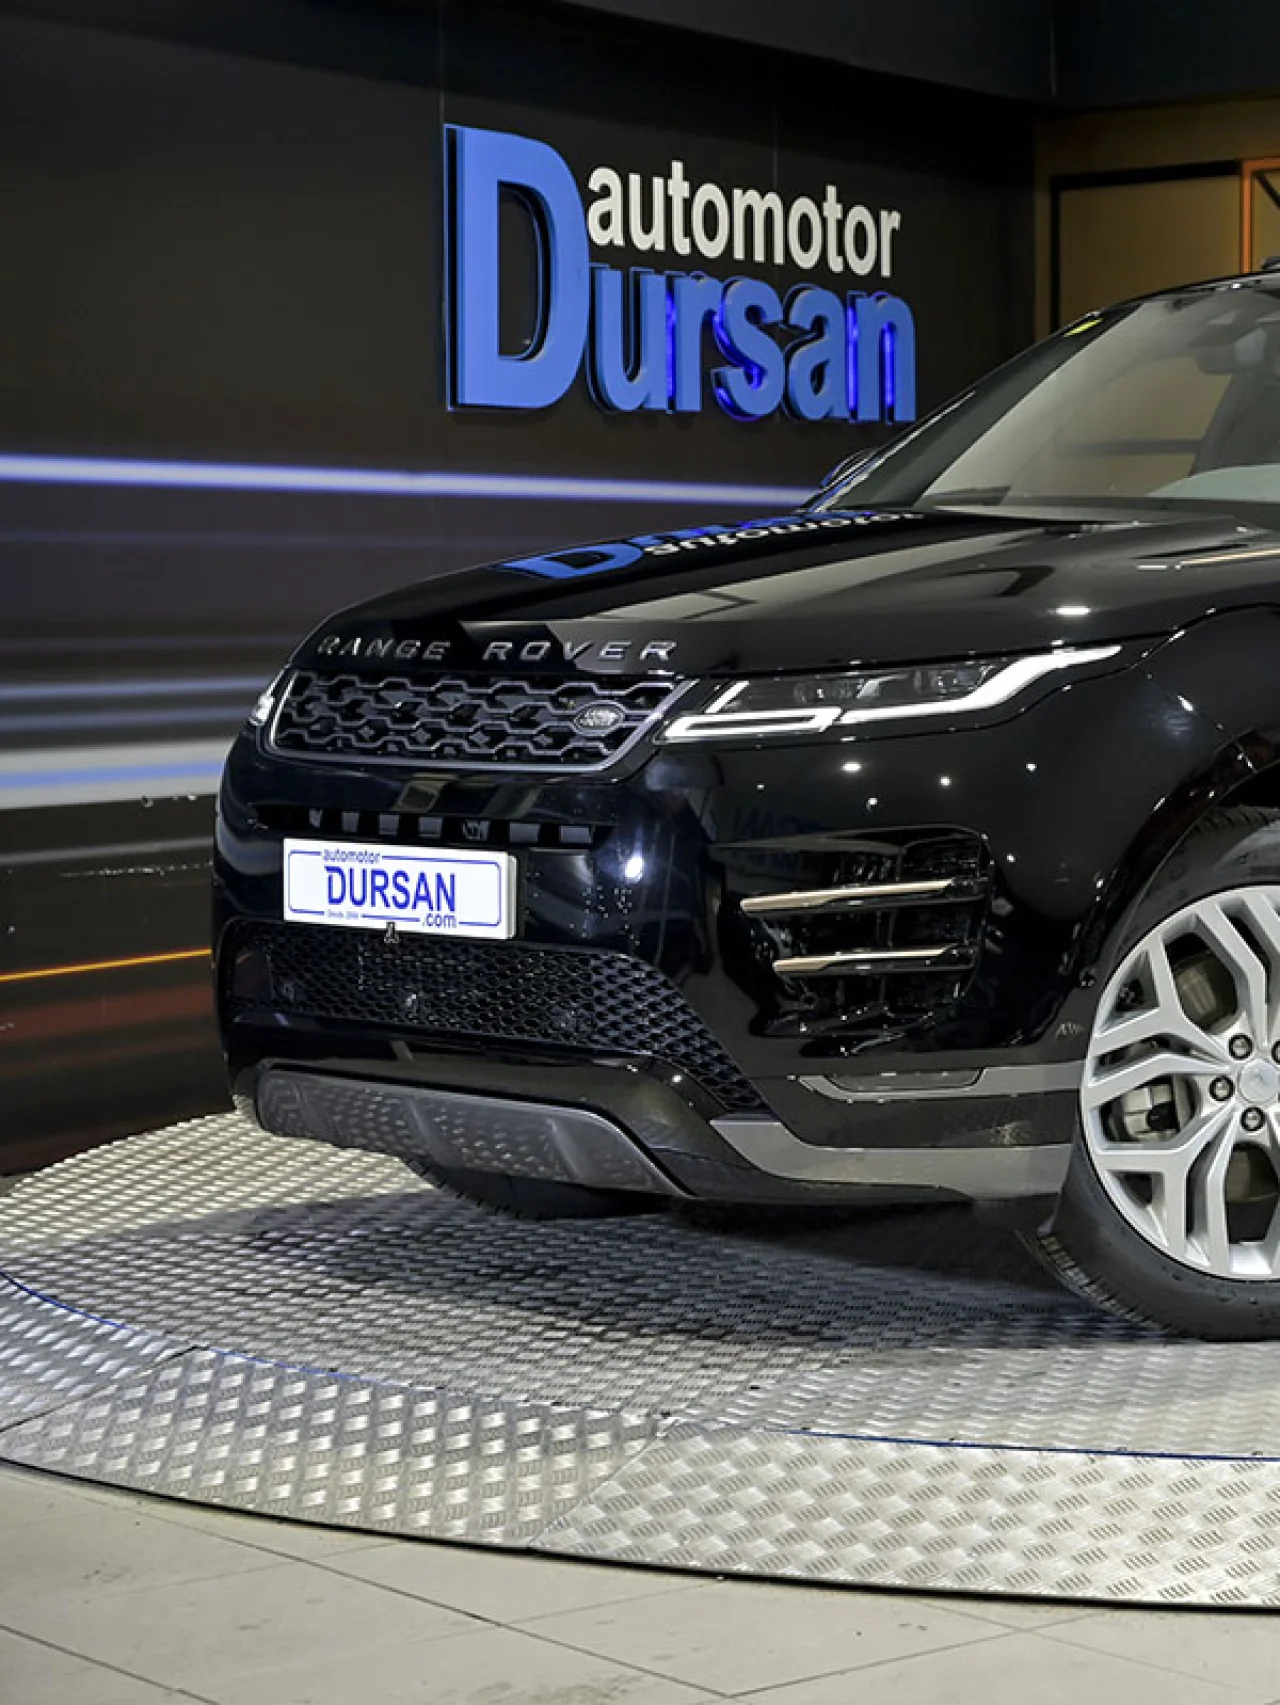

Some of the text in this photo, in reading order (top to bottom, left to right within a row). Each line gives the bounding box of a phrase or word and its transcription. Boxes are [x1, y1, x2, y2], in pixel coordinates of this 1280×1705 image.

[587, 160, 901, 278] automotor
[444, 124, 917, 425] Dursan
[317, 637, 677, 662] RANGE ROVER
[322, 848, 381, 864] automotor
[324, 865, 456, 913] DURSAN
[421, 912, 457, 929] .com
